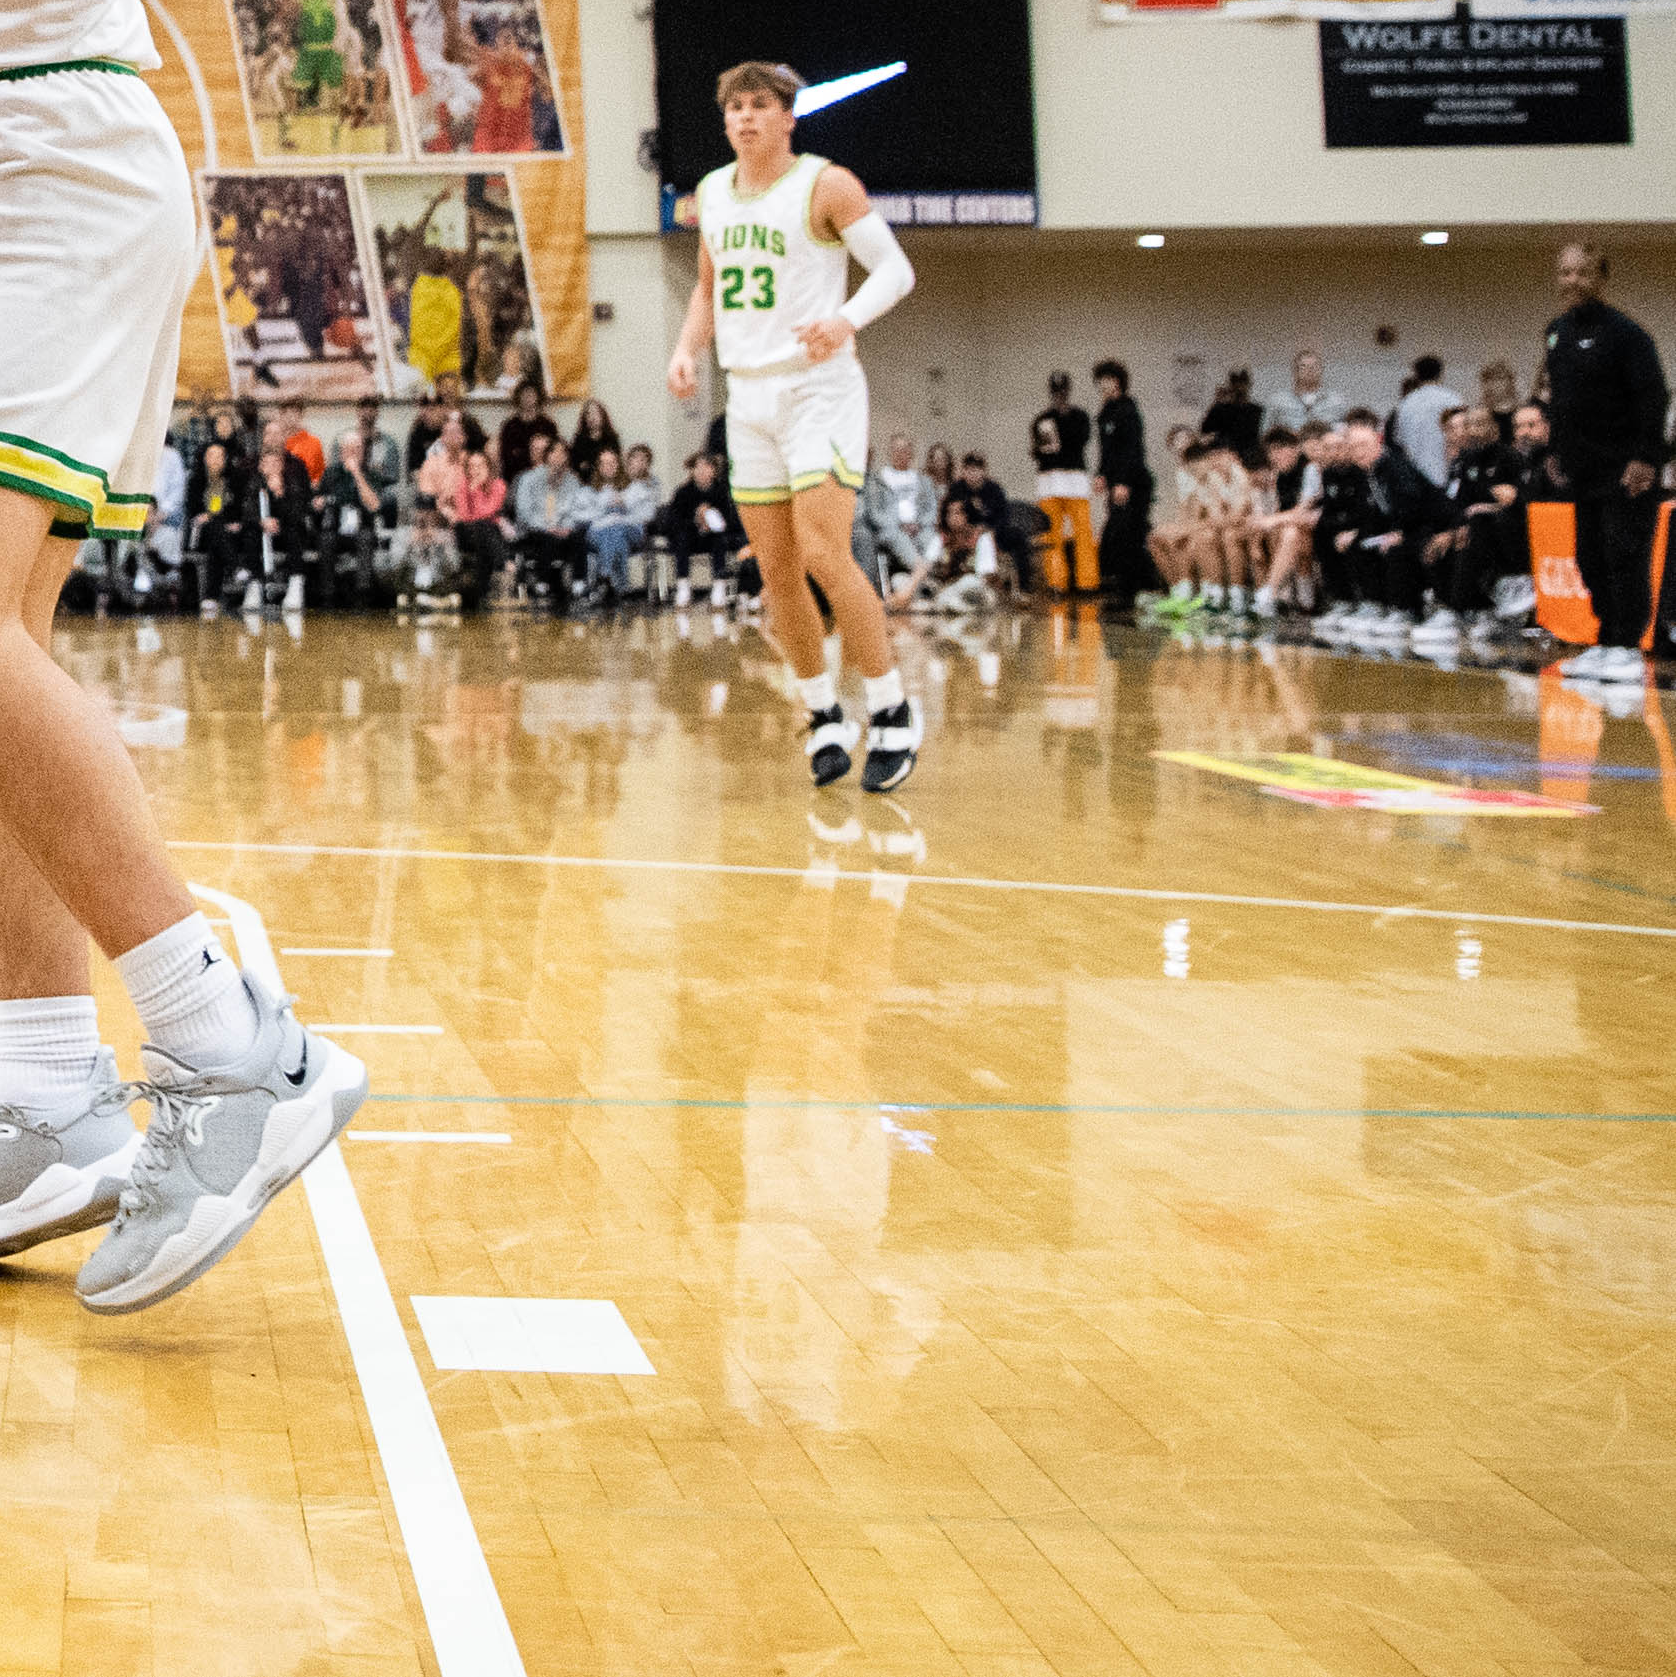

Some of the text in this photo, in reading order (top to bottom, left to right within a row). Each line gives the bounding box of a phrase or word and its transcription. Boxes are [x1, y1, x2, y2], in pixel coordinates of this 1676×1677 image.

[1341, 23, 1603, 51] WOLFE DENTAL
[720, 264, 777, 311] 23
